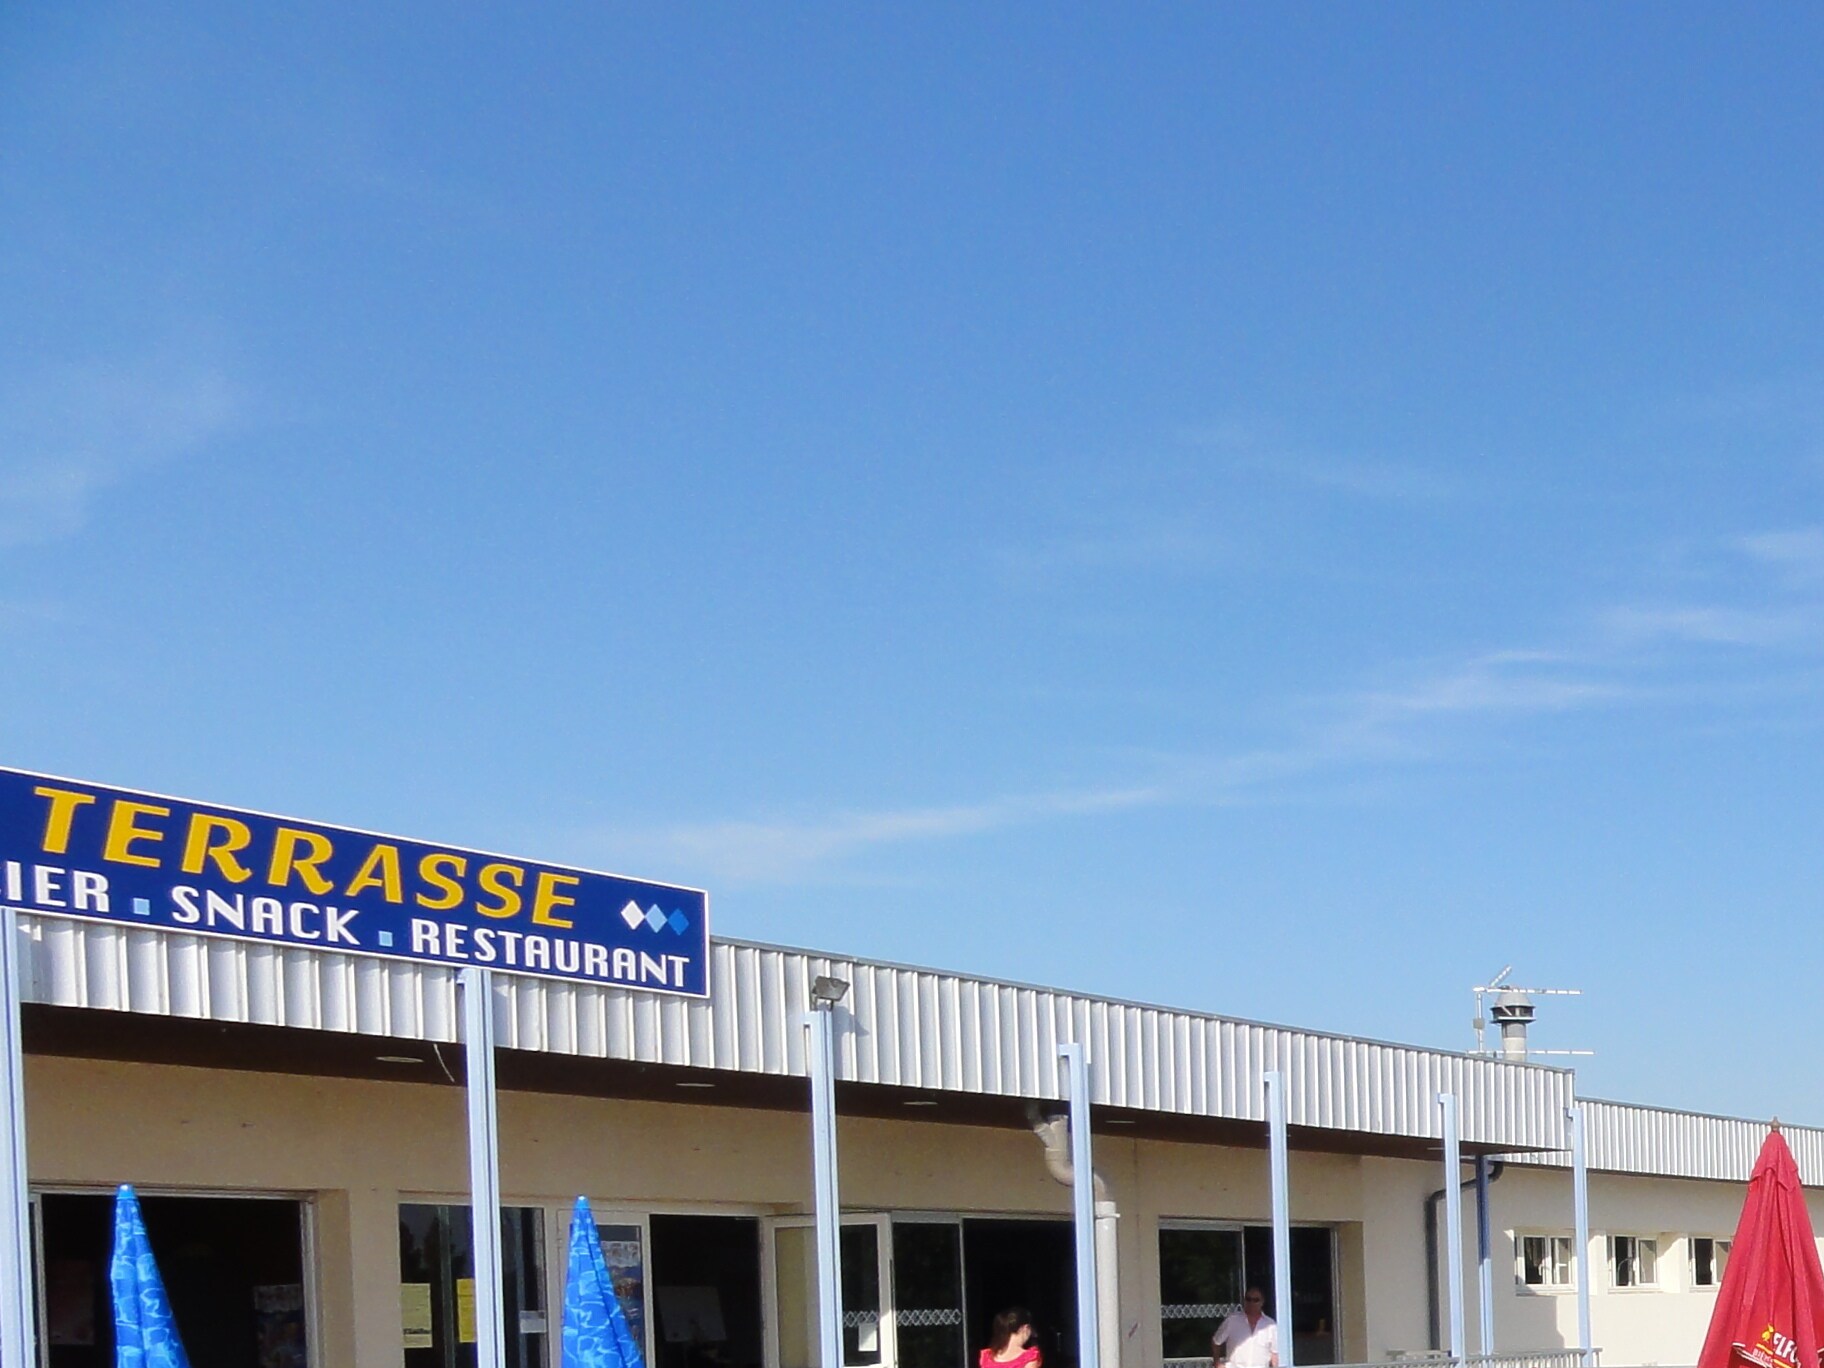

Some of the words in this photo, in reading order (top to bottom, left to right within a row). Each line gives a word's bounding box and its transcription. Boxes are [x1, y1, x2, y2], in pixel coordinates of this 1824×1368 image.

[0, 860, 110, 913] IER
[171, 885, 361, 946] SNACK
[411, 918, 690, 988] RESTAURANT
[34, 786, 579, 929] TERRASSE
